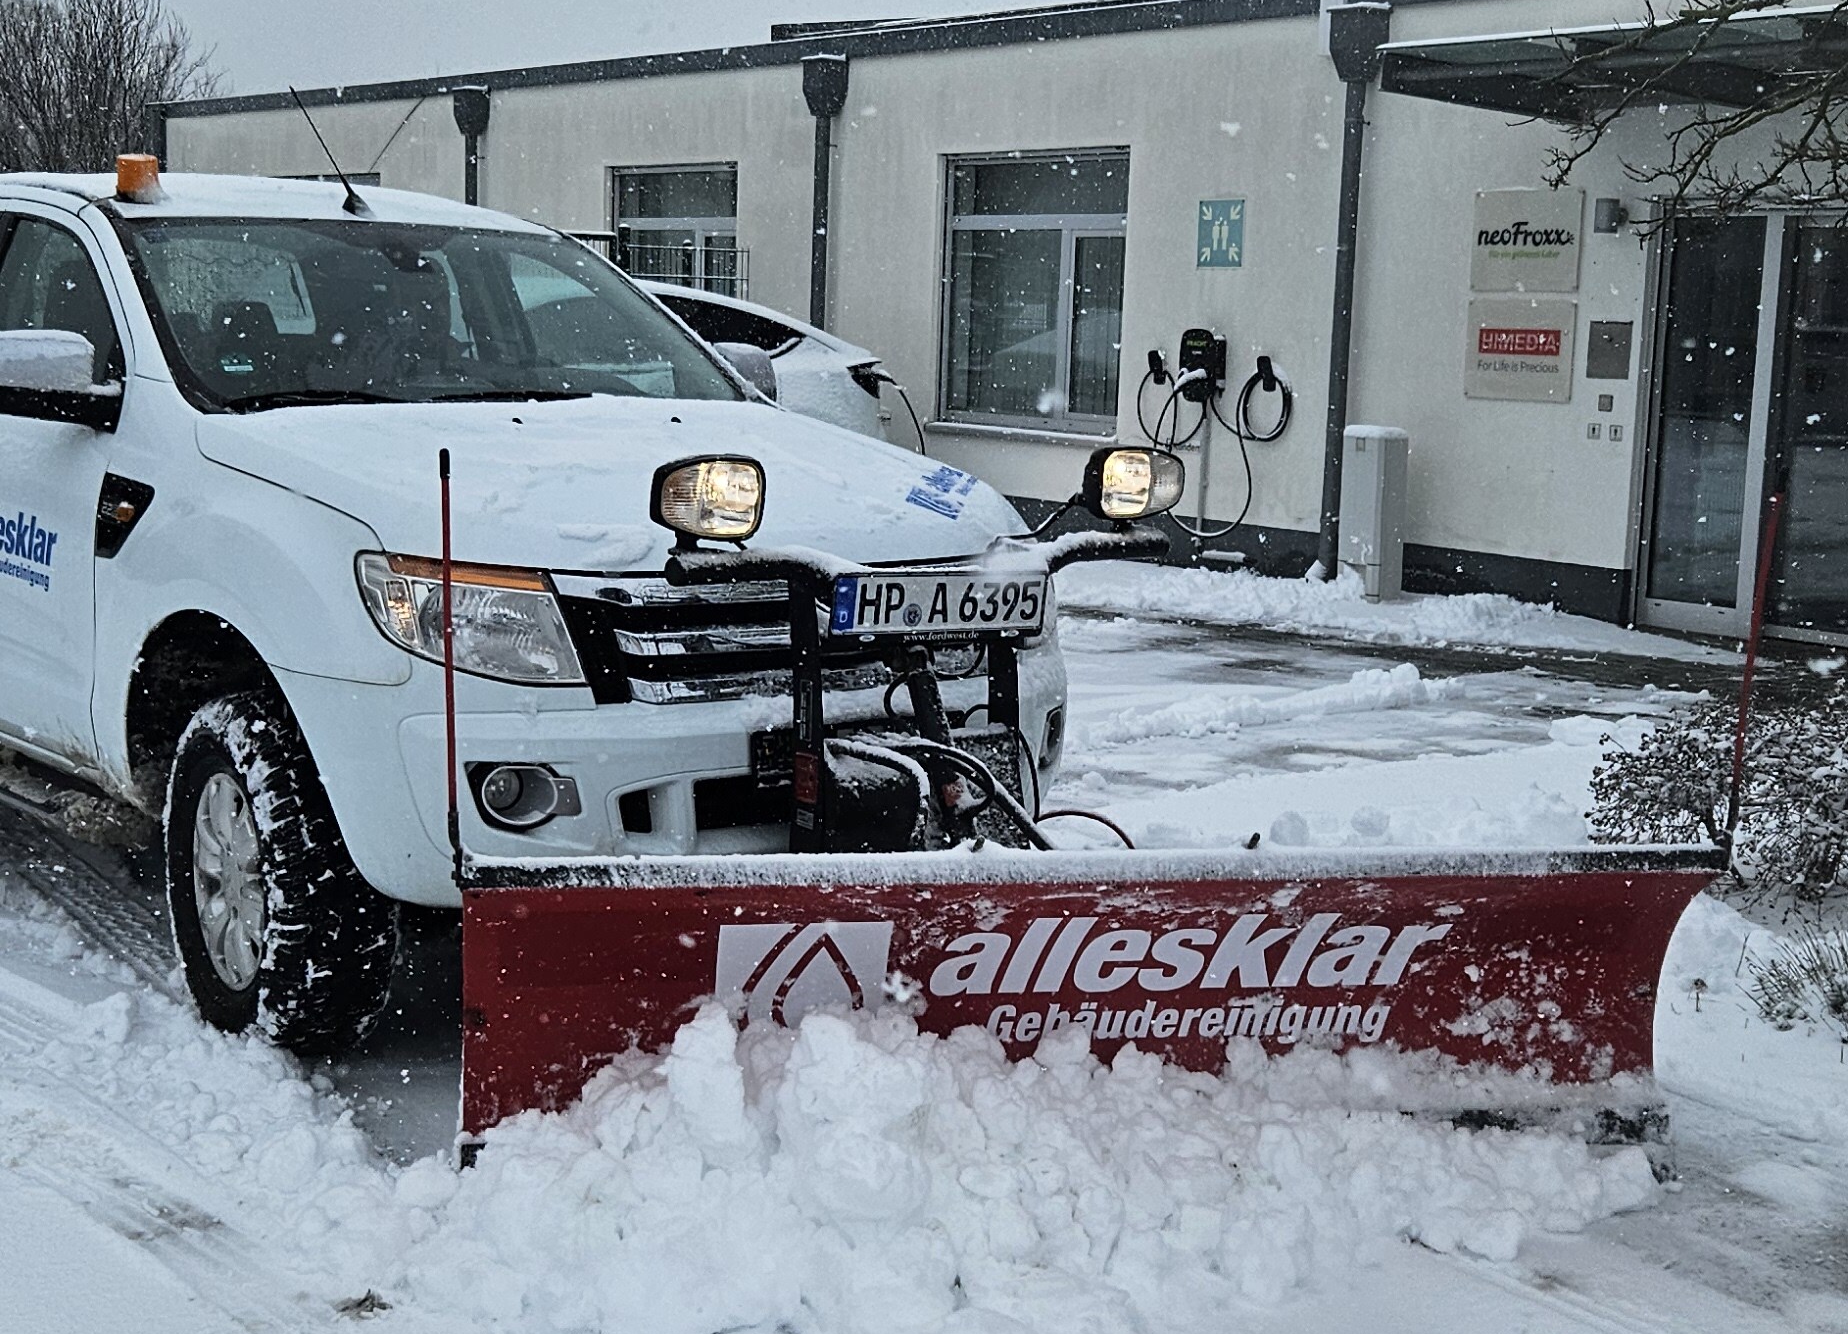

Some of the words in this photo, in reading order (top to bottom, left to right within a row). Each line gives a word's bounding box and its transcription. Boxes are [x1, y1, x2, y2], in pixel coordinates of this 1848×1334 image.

[1477, 221, 1570, 247] neoFroxx
[1481, 332, 1557, 352] HIMEDIA
[1477, 359, 1492, 371] For
[1493, 359, 1510, 372] Life
[1511, 360, 1519, 373] is
[1520, 360, 1560, 374] Precious
[857, 582, 906, 625] HP
[927, 582, 949, 624] A
[958, 580, 1042, 623] 6395
[839, 610, 849, 623] D
[902, 630, 980, 644] www.fordwest.de
[929, 912, 1455, 997] allesklar
[986, 999, 1392, 1044] Gebäudereinigung
